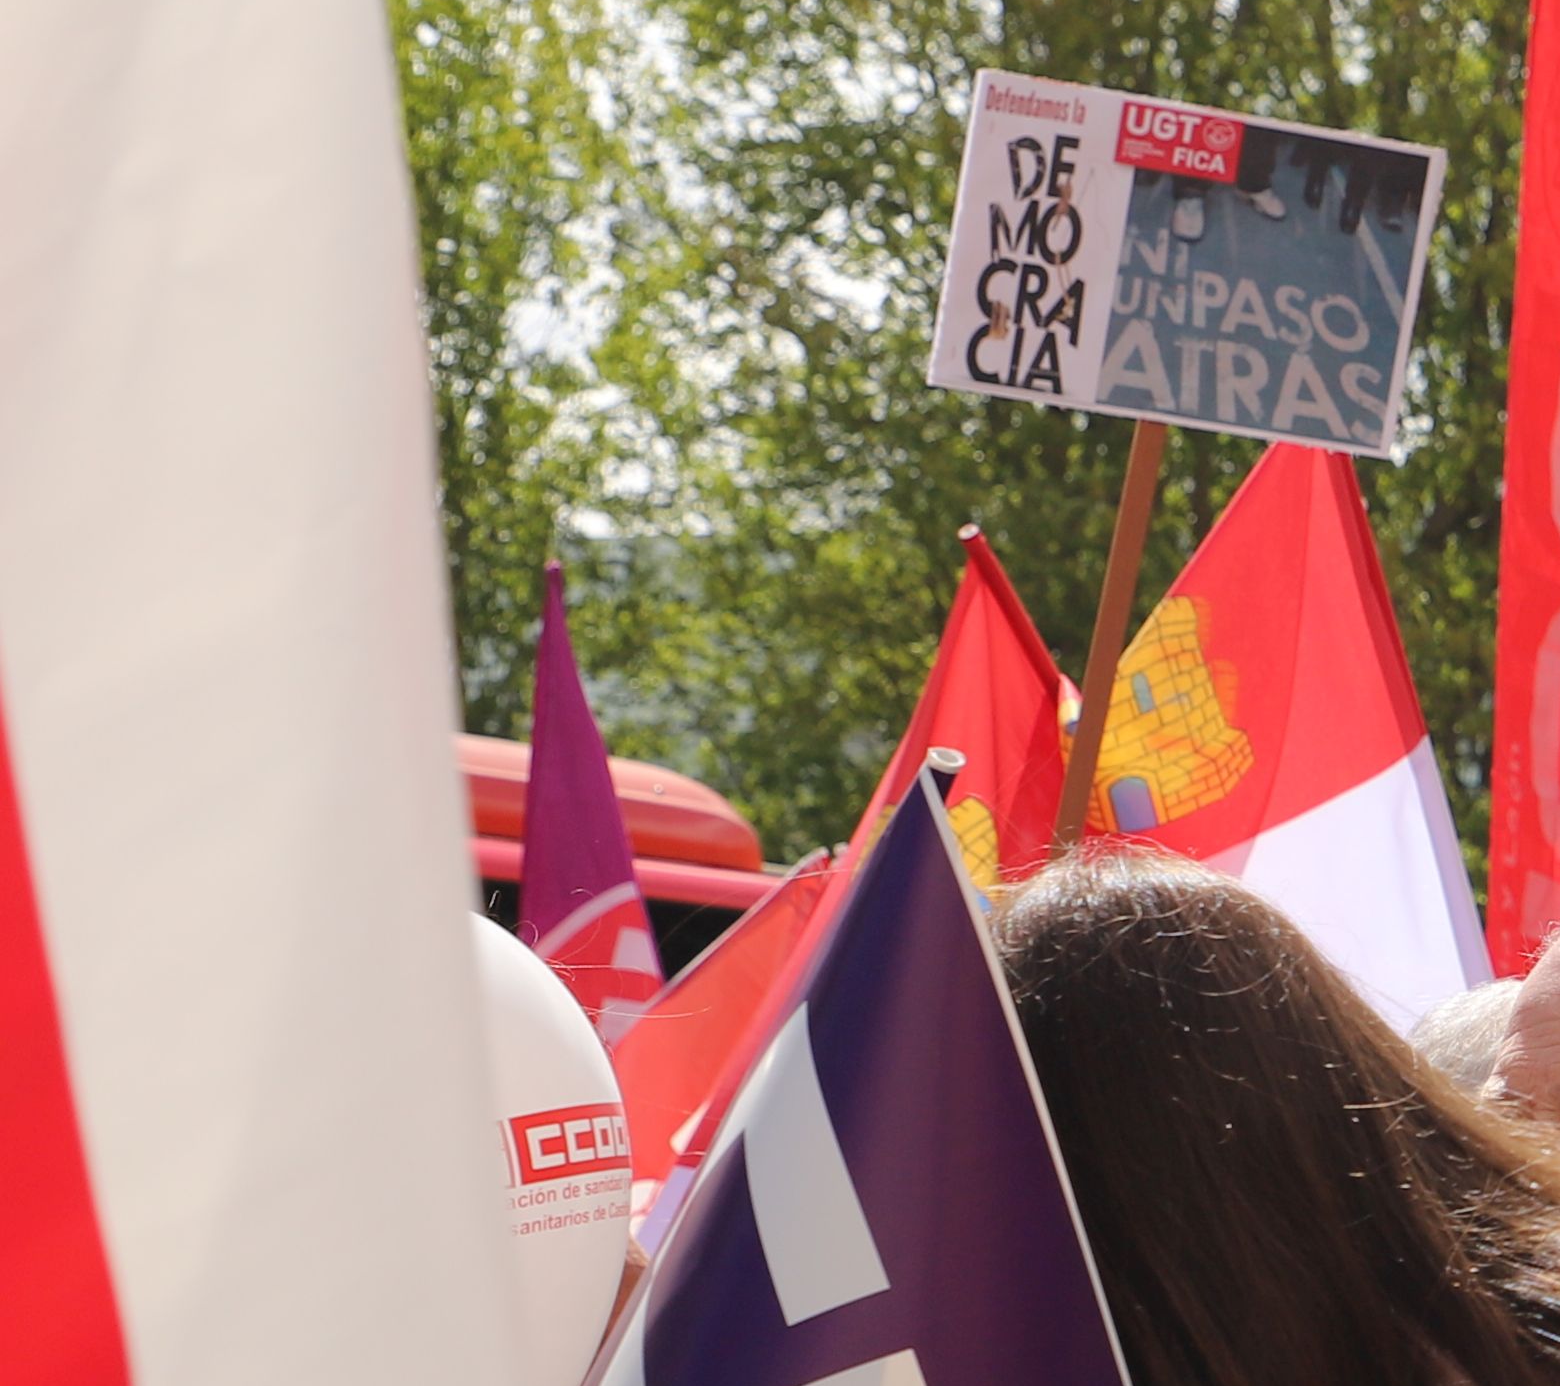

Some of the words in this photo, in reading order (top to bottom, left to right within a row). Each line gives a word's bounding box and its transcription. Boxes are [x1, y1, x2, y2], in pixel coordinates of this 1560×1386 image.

[985, 84, 1069, 123] Defendamos
[1072, 96, 1086, 125] la
[1126, 104, 1202, 144] UGT
[1007, 135, 1081, 200] DE
[1172, 146, 1226, 174] FICA
[988, 199, 1082, 266] MO
[975, 261, 1086, 348] CRA
[1193, 271, 1370, 353] PASO
[965, 323, 1062, 395] CIA
[562, 1183, 581, 1200] de
[593, 1205, 606, 1222] de
